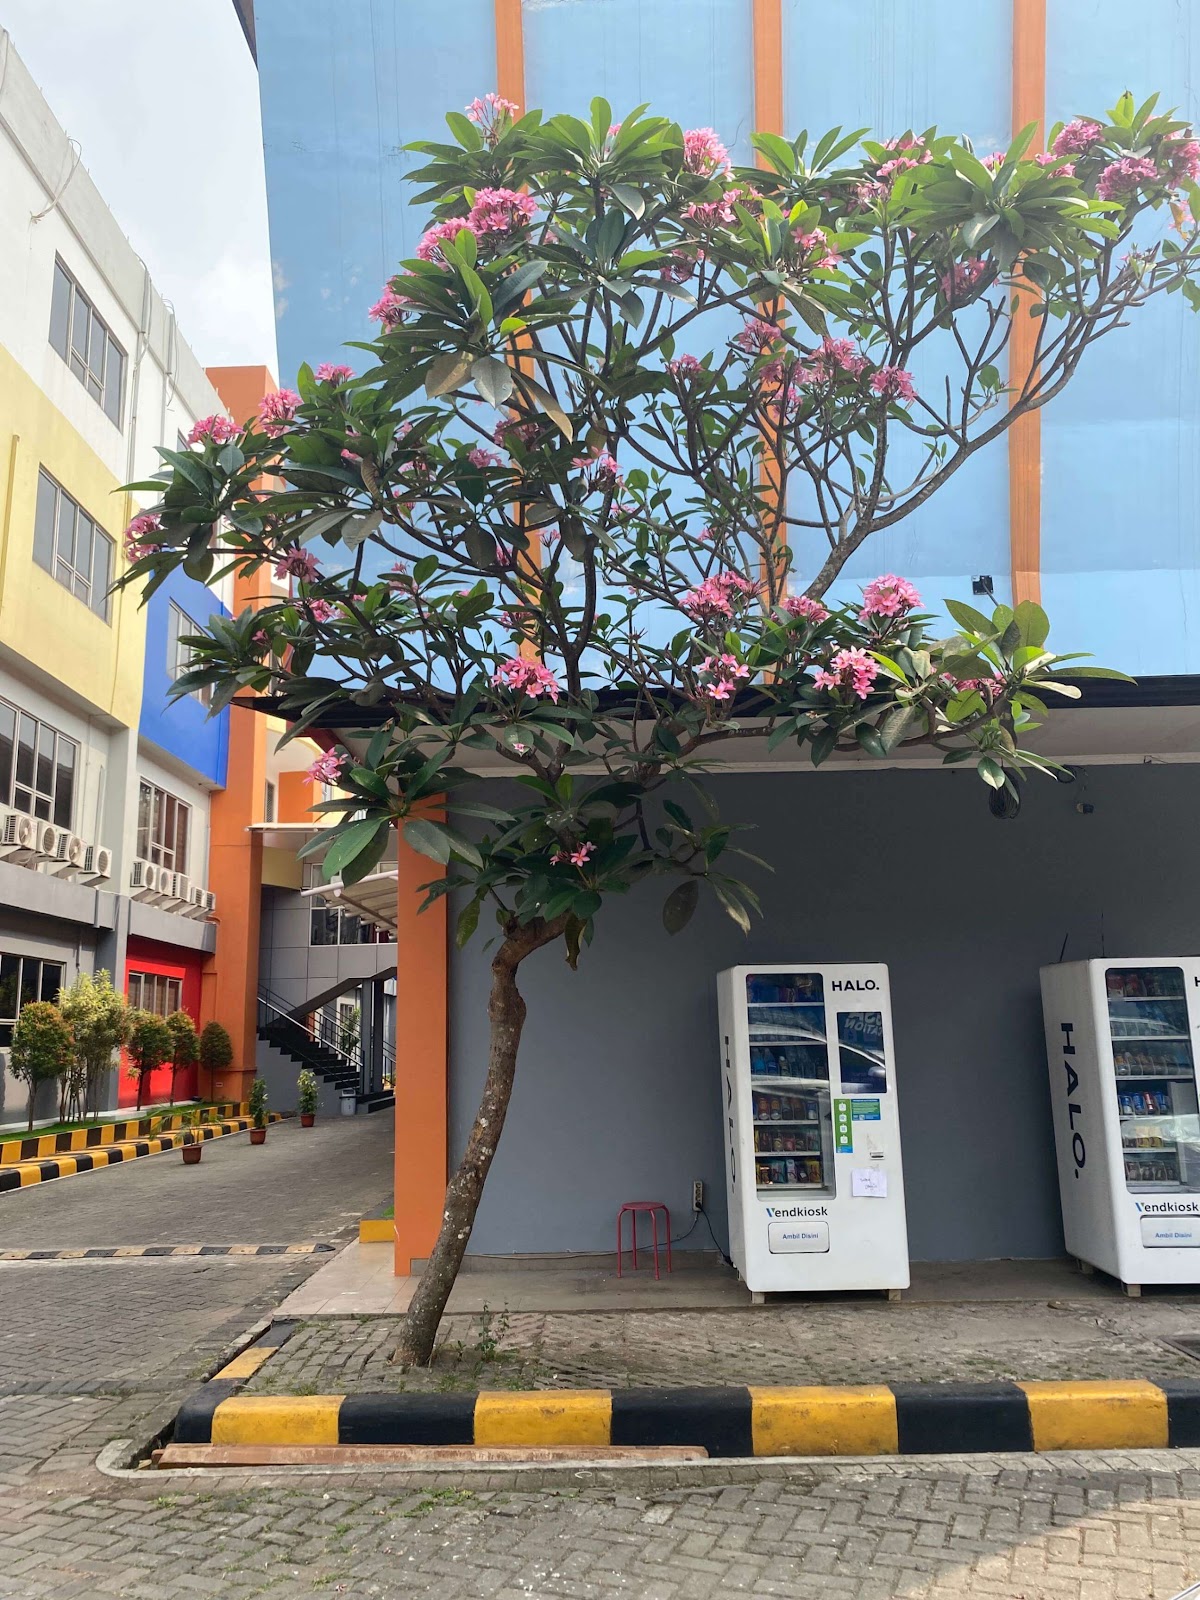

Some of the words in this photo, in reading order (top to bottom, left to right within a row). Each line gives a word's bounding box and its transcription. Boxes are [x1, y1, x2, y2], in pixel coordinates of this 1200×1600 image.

[831, 979, 880, 992] HALO.
[1060, 1022, 1086, 1180] HALO.
[765, 1206, 829, 1218] Vendkiosk
[1135, 1201, 1200, 1213] Vendkiosk
[801, 1232, 819, 1240] Disini
